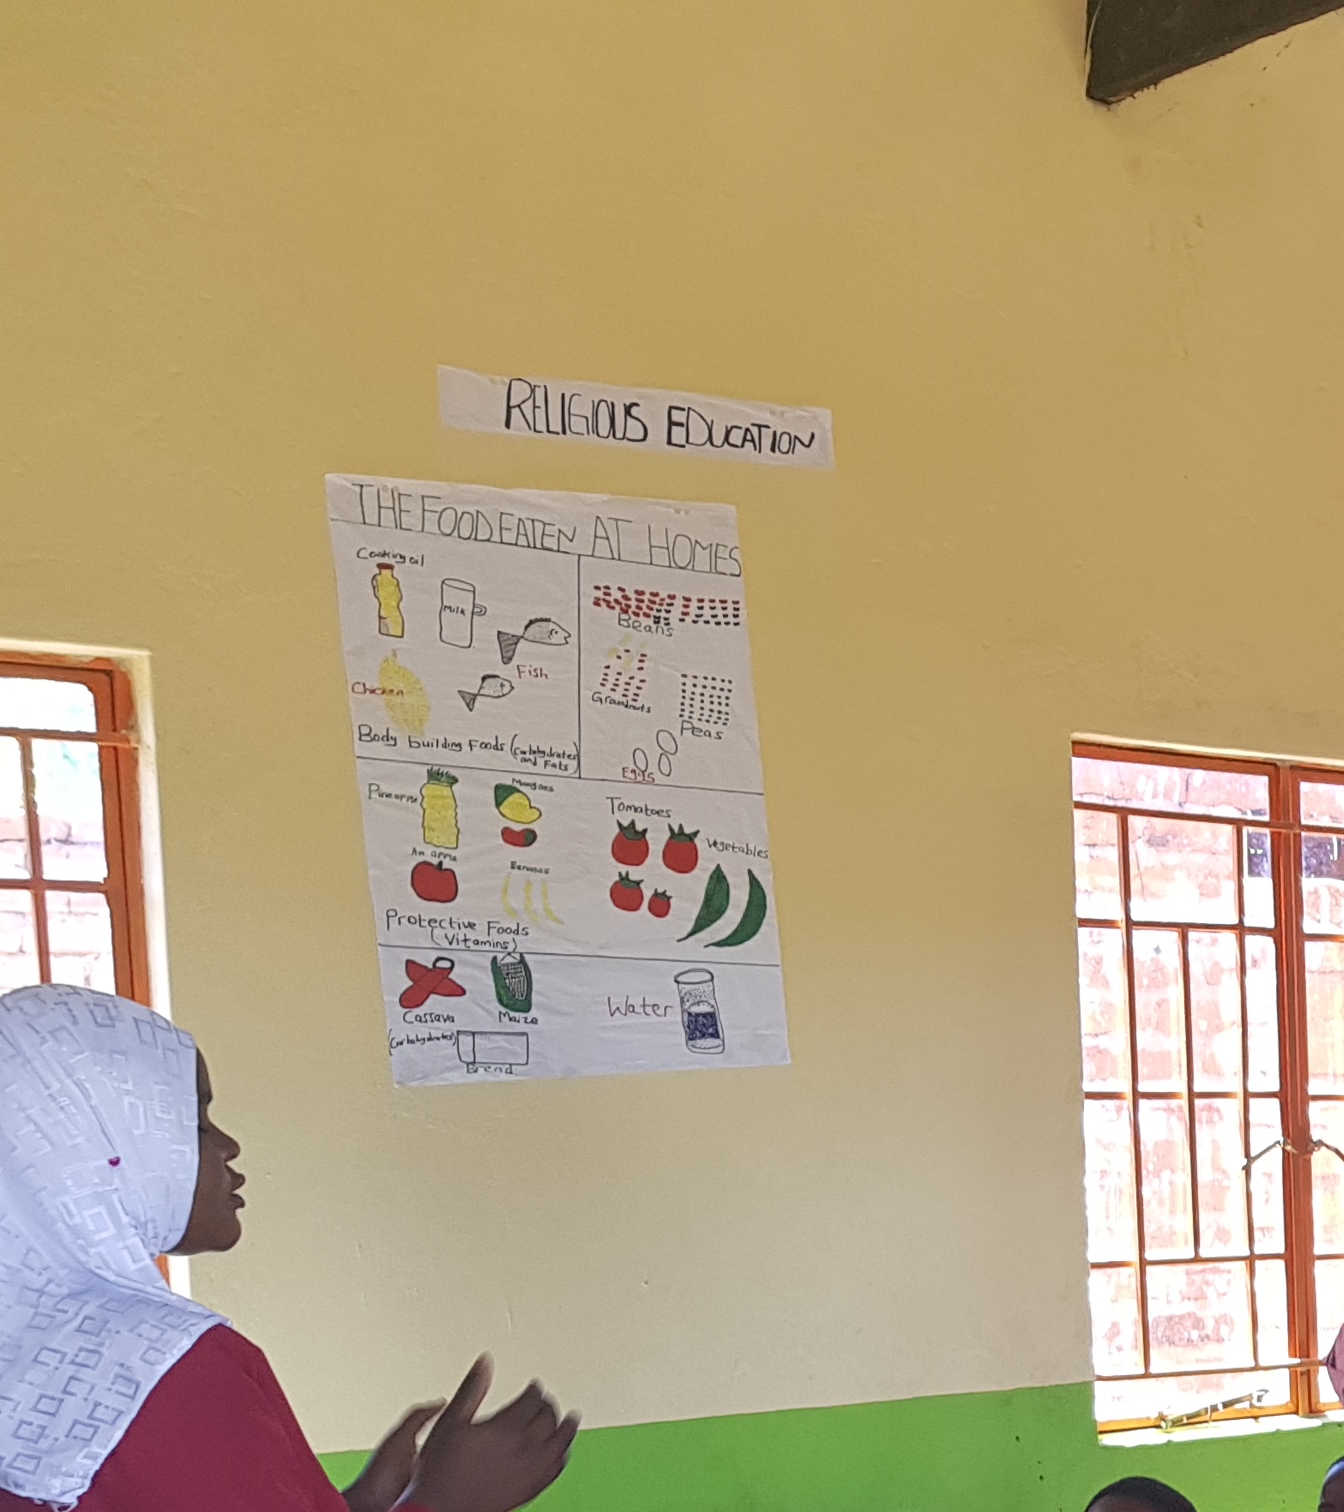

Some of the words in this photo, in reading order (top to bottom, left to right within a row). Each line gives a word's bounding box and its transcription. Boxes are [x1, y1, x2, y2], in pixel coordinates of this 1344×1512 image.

[504, 377, 649, 443] RELIGIOUS
[666, 405, 817, 456] EDUCATION
[351, 482, 412, 531] THE
[420, 495, 493, 543] FOOD
[499, 512, 577, 555] EATEN
[592, 514, 633, 561] AT
[648, 523, 742, 577] HOMES
[356, 547, 406, 564] Cooking
[409, 554, 424, 567] oil
[618, 612, 674, 637] Beans
[516, 664, 549, 680] Fish
[358, 724, 397, 746] Body
[408, 735, 462, 752] building
[681, 720, 723, 740] Peas
[520, 756, 537, 766] and
[606, 796, 672, 818] Tomatoes
[706, 837, 769, 859] Vegetables
[386, 909, 476, 931] Protective
[487, 921, 530, 937] Foods
[403, 1010, 455, 1024] Cassava
[499, 1010, 539, 1025] Maize
[607, 995, 673, 1018] Water
